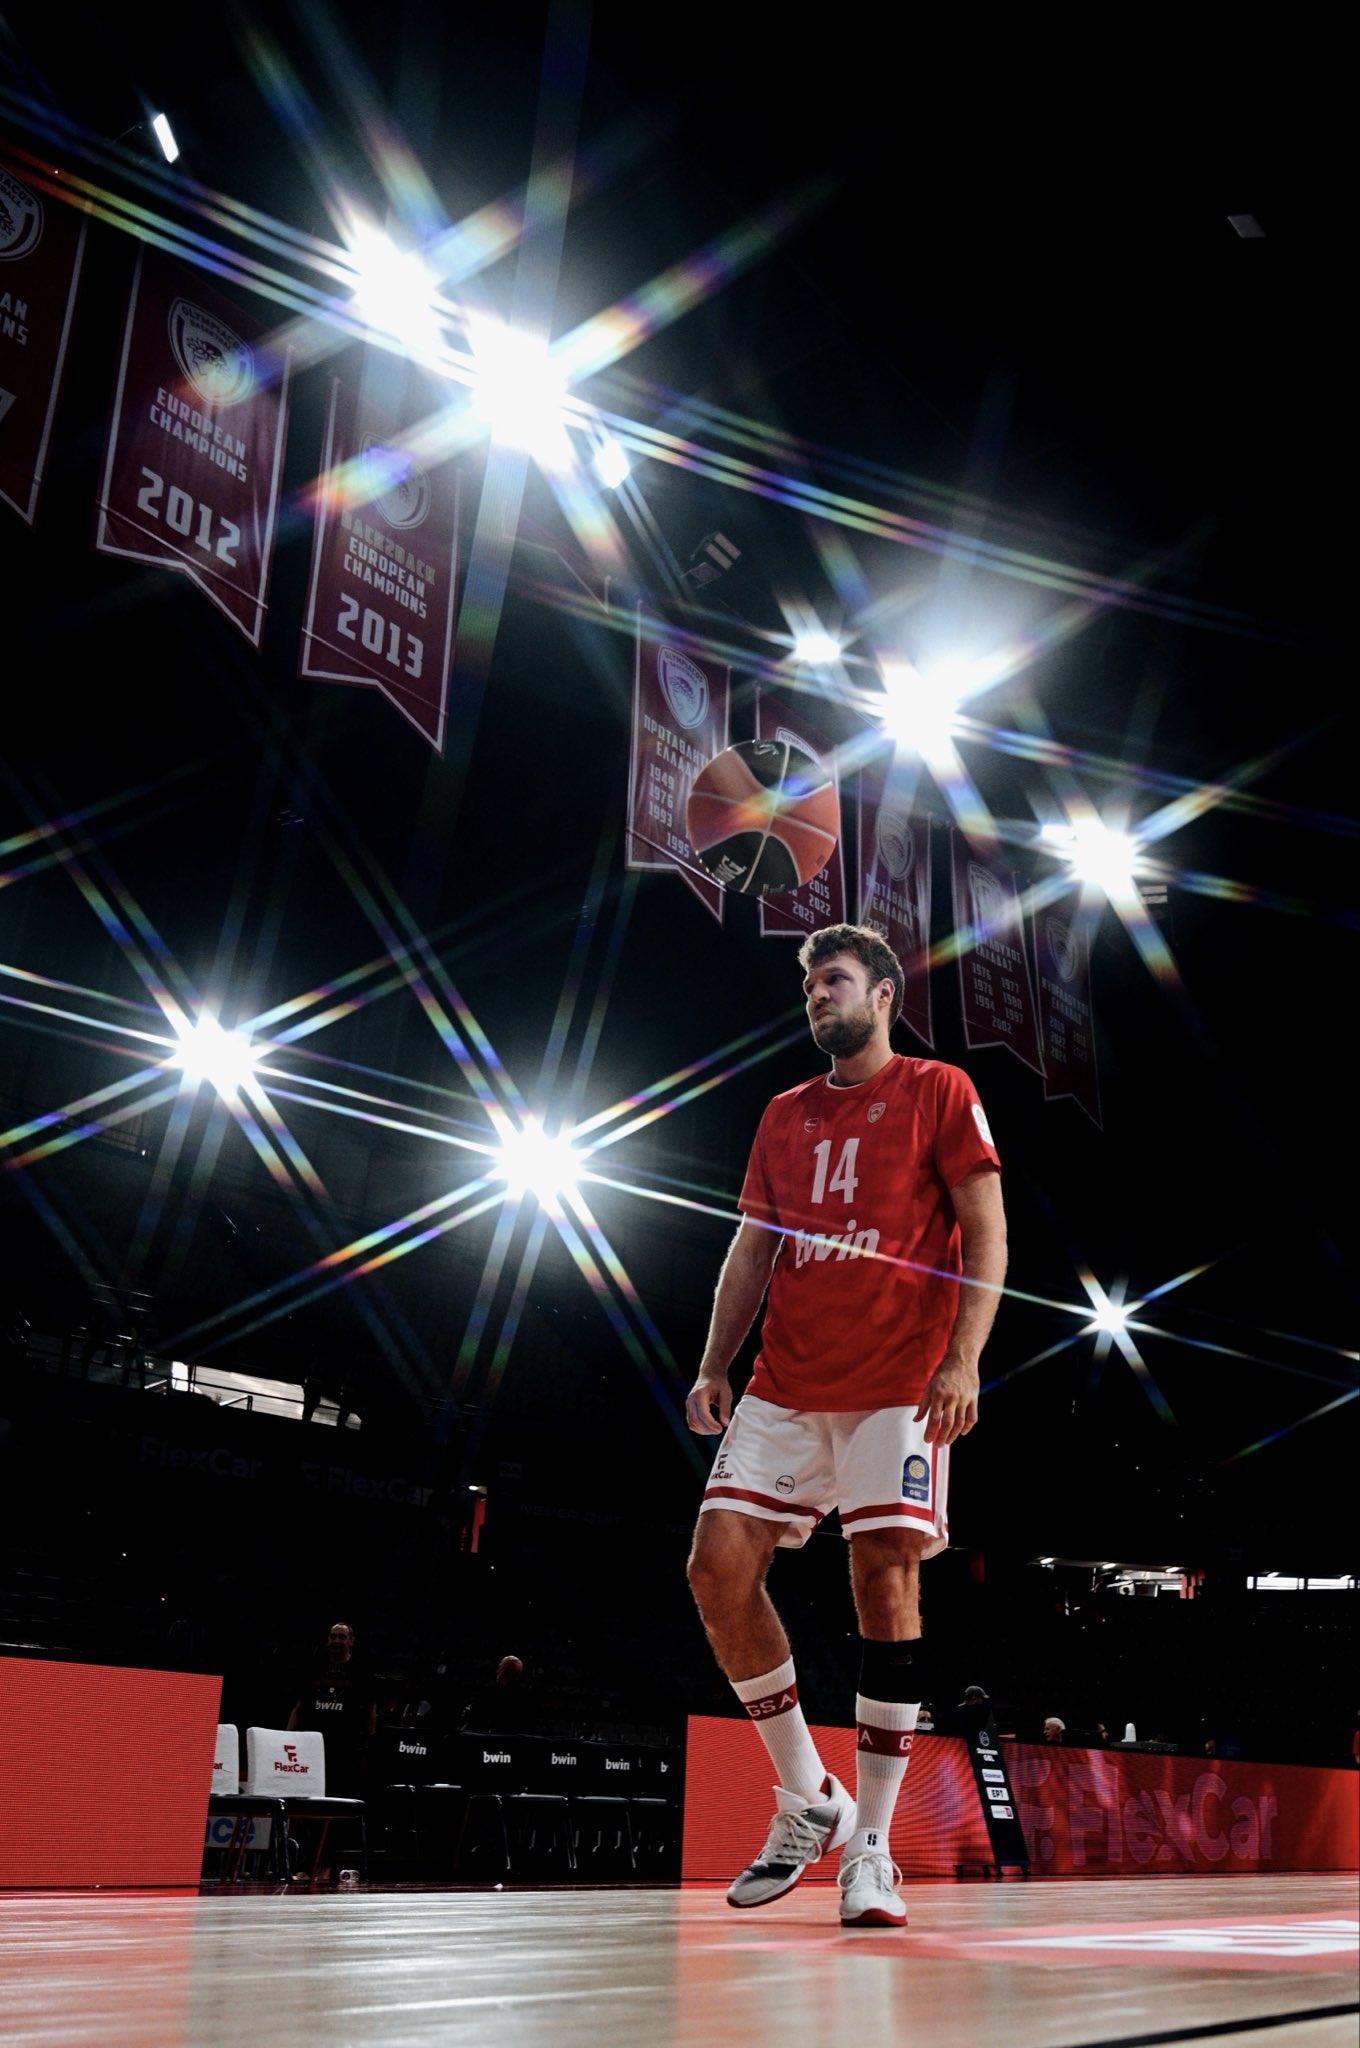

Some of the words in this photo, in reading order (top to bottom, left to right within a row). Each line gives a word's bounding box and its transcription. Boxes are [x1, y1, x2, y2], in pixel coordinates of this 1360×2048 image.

[157, 387, 246, 461] EUROPEAN
[150, 404, 248, 483] CHAMPIONS
[137, 465, 241, 568] 2012
[349, 536, 426, 598] EUROPEAN
[344, 556, 428, 620] CHAMPIONS
[336, 592, 424, 679] 2013
[650, 763, 675, 791] 1949
[649, 782, 674, 810] 1976
[648, 801, 673, 829] 1993
[667, 832, 690, 859] 1995
[792, 901, 815, 925] 2023
[809, 893, 831, 917] 2022
[811, 1137, 860, 1204] 14
[315, 1700, 343, 1711] bwin
[399, 1741, 427, 1755] bwin
[483, 1751, 511, 1763] bwin
[551, 1753, 577, 1765] bwin
[274, 1761, 310, 1774] FlexCar
[605, 1759, 630, 1770] bwin
[1067, 1763, 1278, 1867] FlexCar
